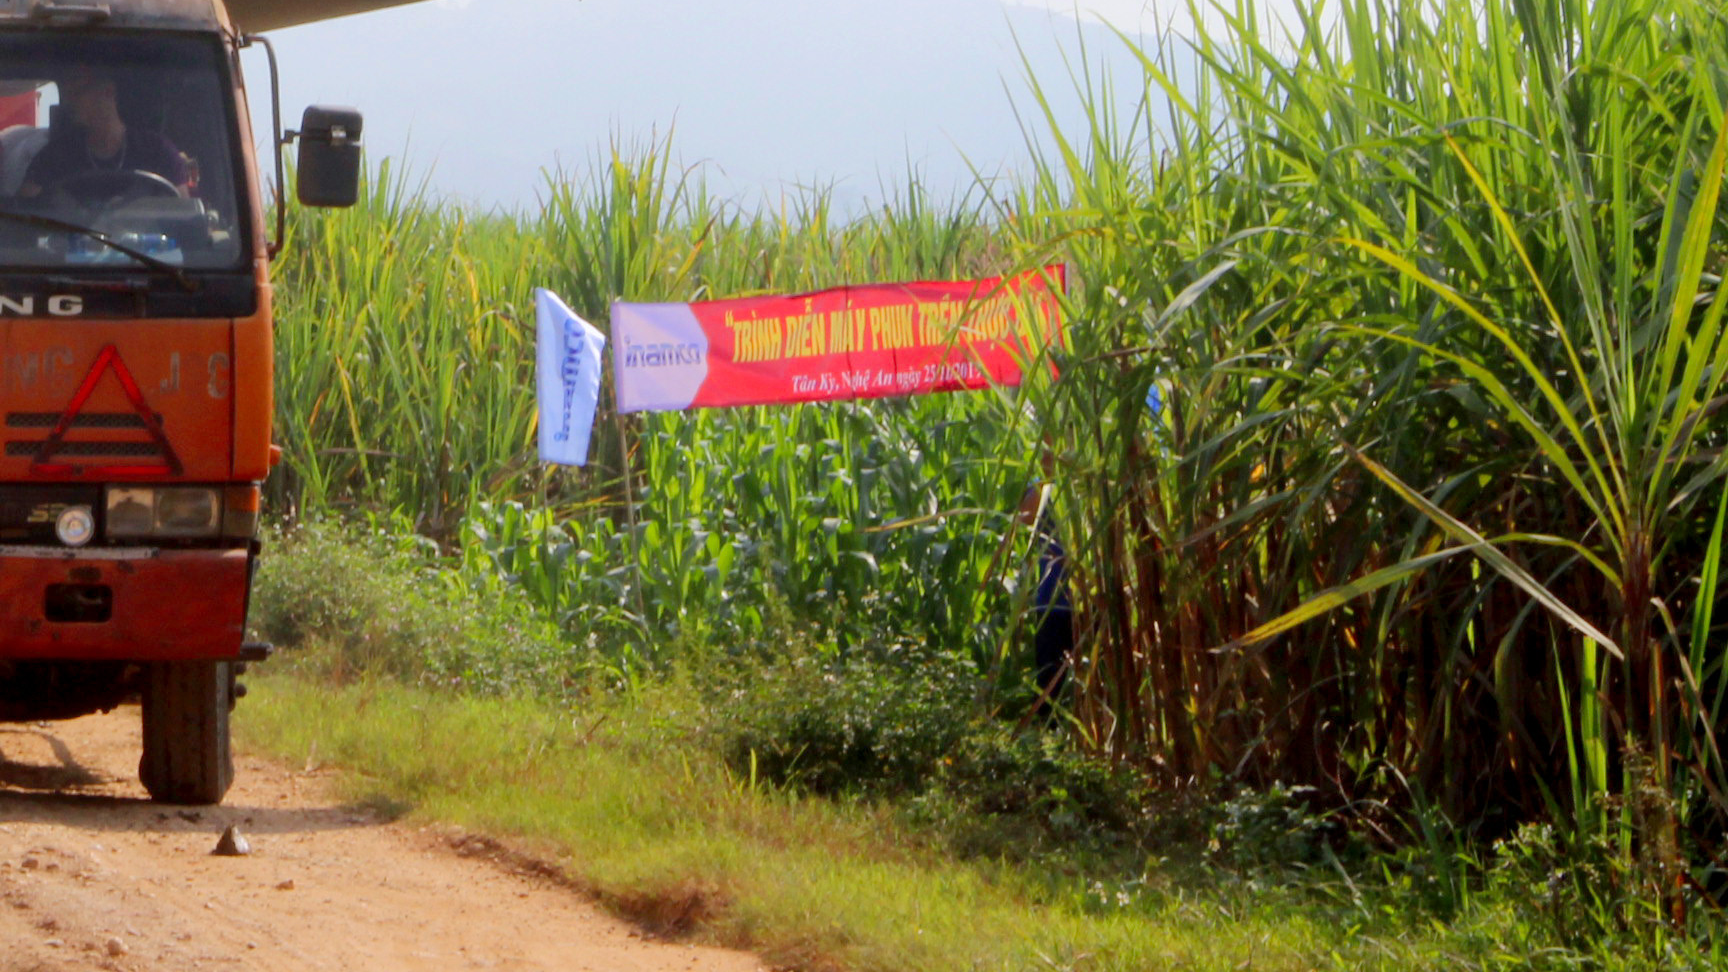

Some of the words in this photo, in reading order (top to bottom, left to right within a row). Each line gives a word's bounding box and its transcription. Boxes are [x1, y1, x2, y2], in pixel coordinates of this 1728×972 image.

[784, 298, 825, 358] DIỄN
[830, 300, 866, 354] MÁY
[869, 304, 915, 351] PHUN
[624, 335, 701, 368] inamco
[792, 374, 816, 393] Tân
[873, 369, 892, 387] An
